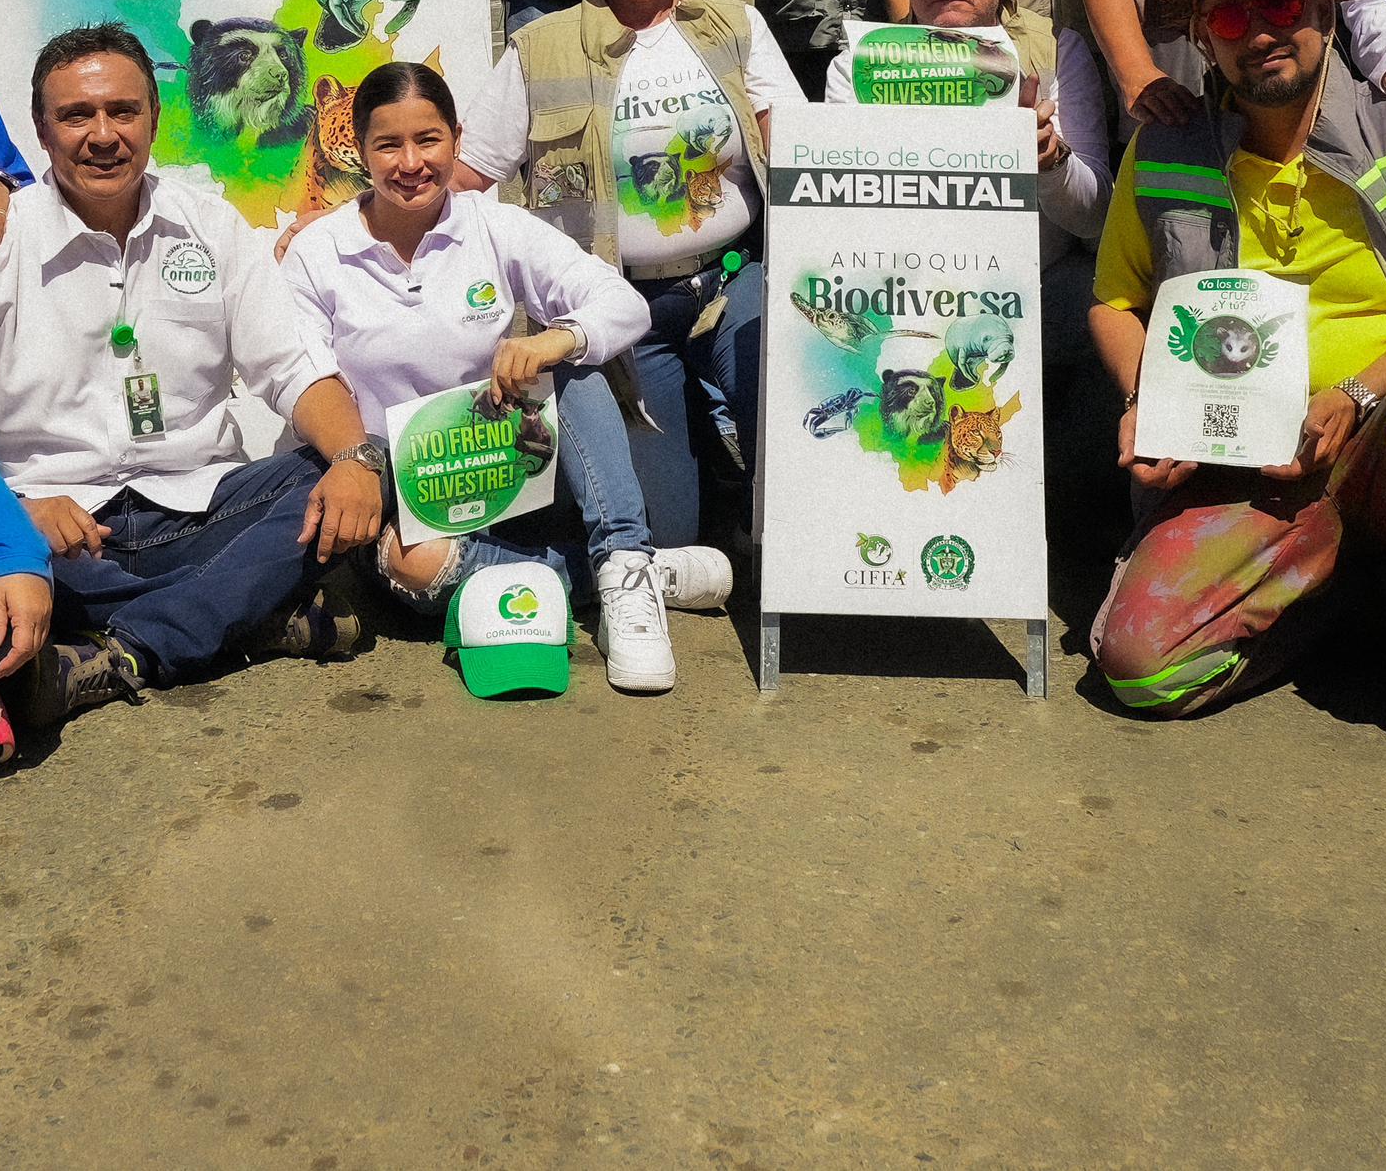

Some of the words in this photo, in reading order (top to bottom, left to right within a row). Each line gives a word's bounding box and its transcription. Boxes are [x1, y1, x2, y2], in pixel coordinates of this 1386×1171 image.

[869, 41, 901, 65] ¡YO
[905, 41, 971, 63] FRENO
[874, 69, 901, 79] POR
[902, 69, 919, 78] LA
[921, 66, 965, 77] FAUNA
[872, 80, 973, 104] SILVESTRE!
[793, 144, 879, 167] Puesto
[888, 146, 919, 168] de
[928, 147, 1020, 170] Control
[789, 172, 1024, 208] AMBIENTAL
[161, 266, 217, 282] Cornare
[831, 252, 1000, 273] ANTIOQUIA
[808, 276, 1023, 319] Biodiversa
[1201, 281, 1214, 289] Yo
[1216, 281, 1232, 289] los
[1235, 281, 1259, 291] dejo
[1212, 301, 1225, 311] ¿Y
[1229, 301, 1246, 310] tú?
[410, 430, 444, 461] ¡YO
[449, 420, 513, 455] FRENO
[417, 463, 444, 476] POR
[446, 460, 463, 471] LA
[464, 451, 507, 468] FAUNA
[417, 464, 514, 503] SILVESTRE!
[844, 569, 907, 586] CIFFA
[485, 629, 552, 640] CORANTIOQUIA
